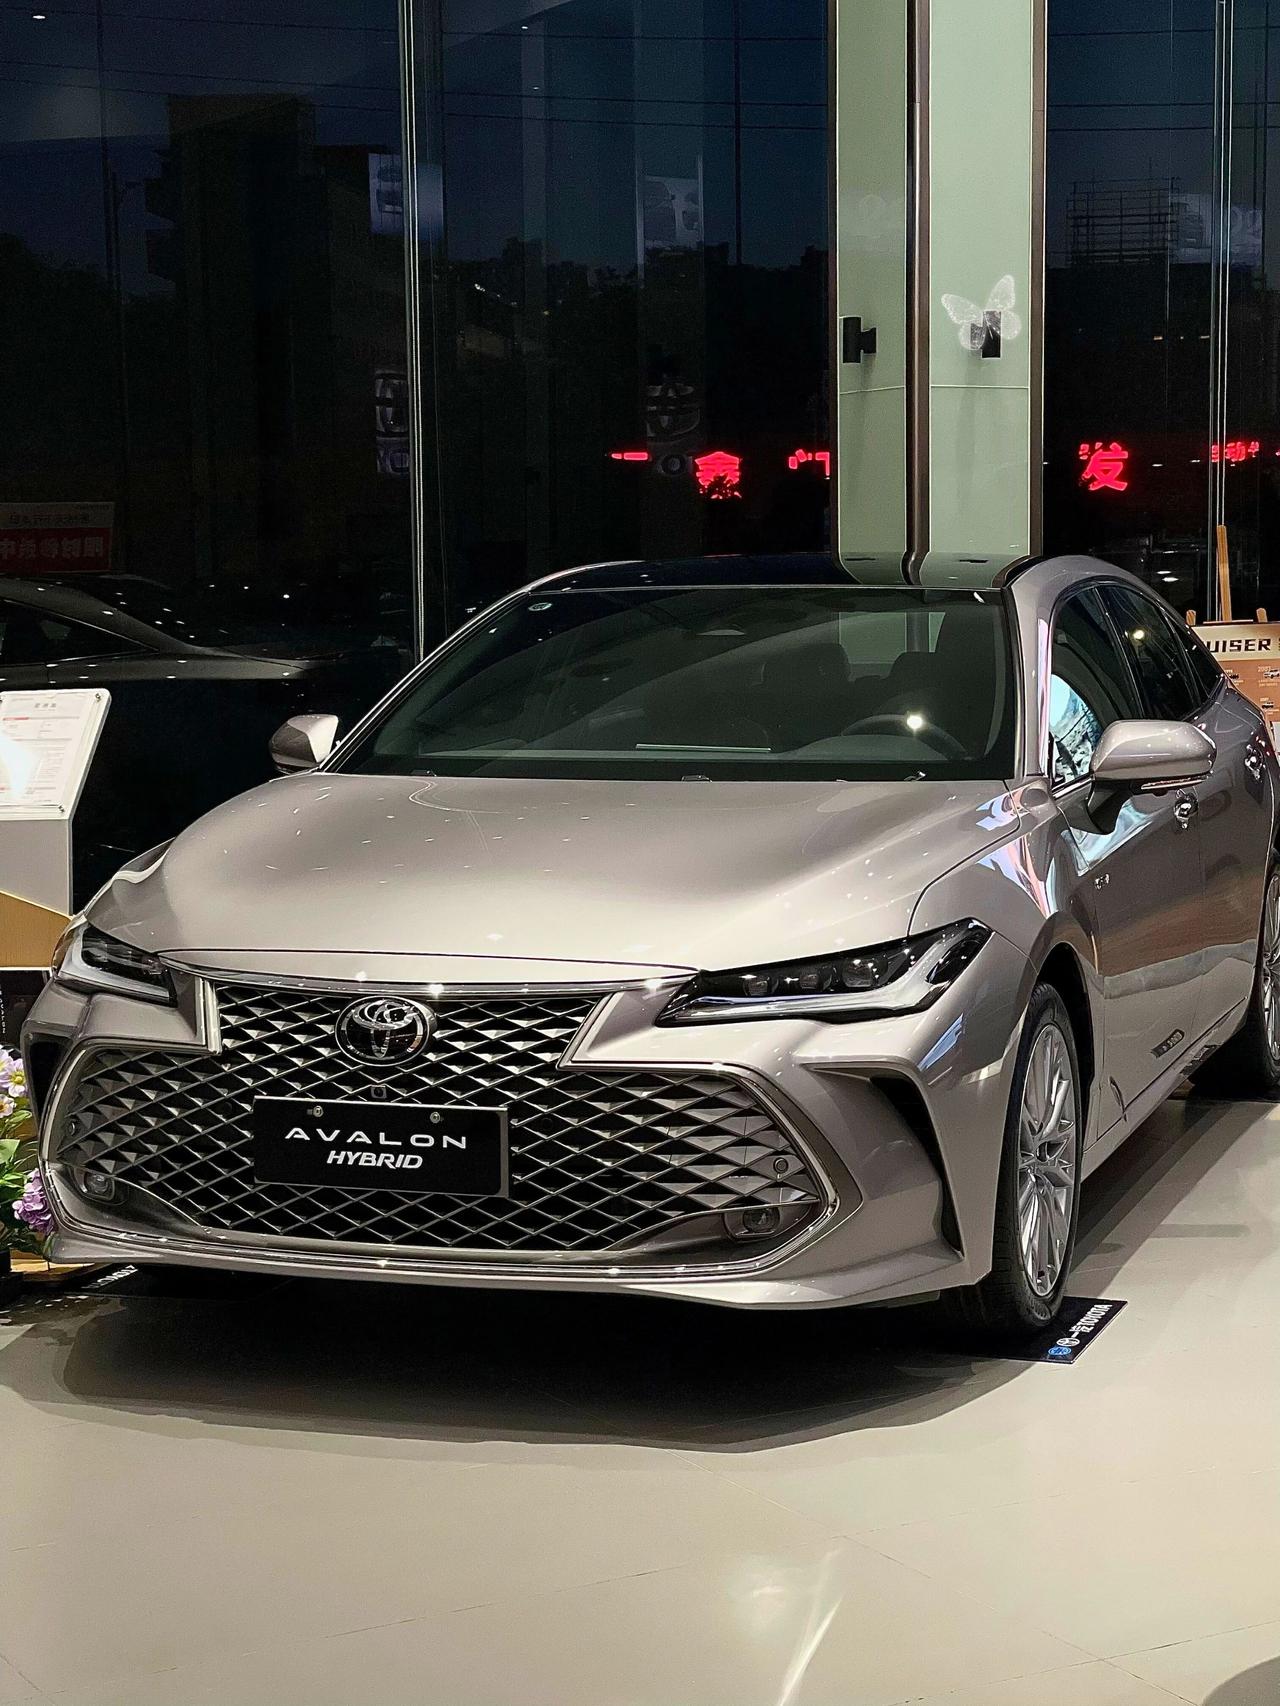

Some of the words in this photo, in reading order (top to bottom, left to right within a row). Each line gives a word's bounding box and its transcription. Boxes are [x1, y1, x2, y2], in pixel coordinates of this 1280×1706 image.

[1079, 442, 1129, 491] 发
[1207, 638, 1271, 653] UISER
[284, 1127, 467, 1149] AVALON
[326, 1150, 423, 1169] HYBRID
